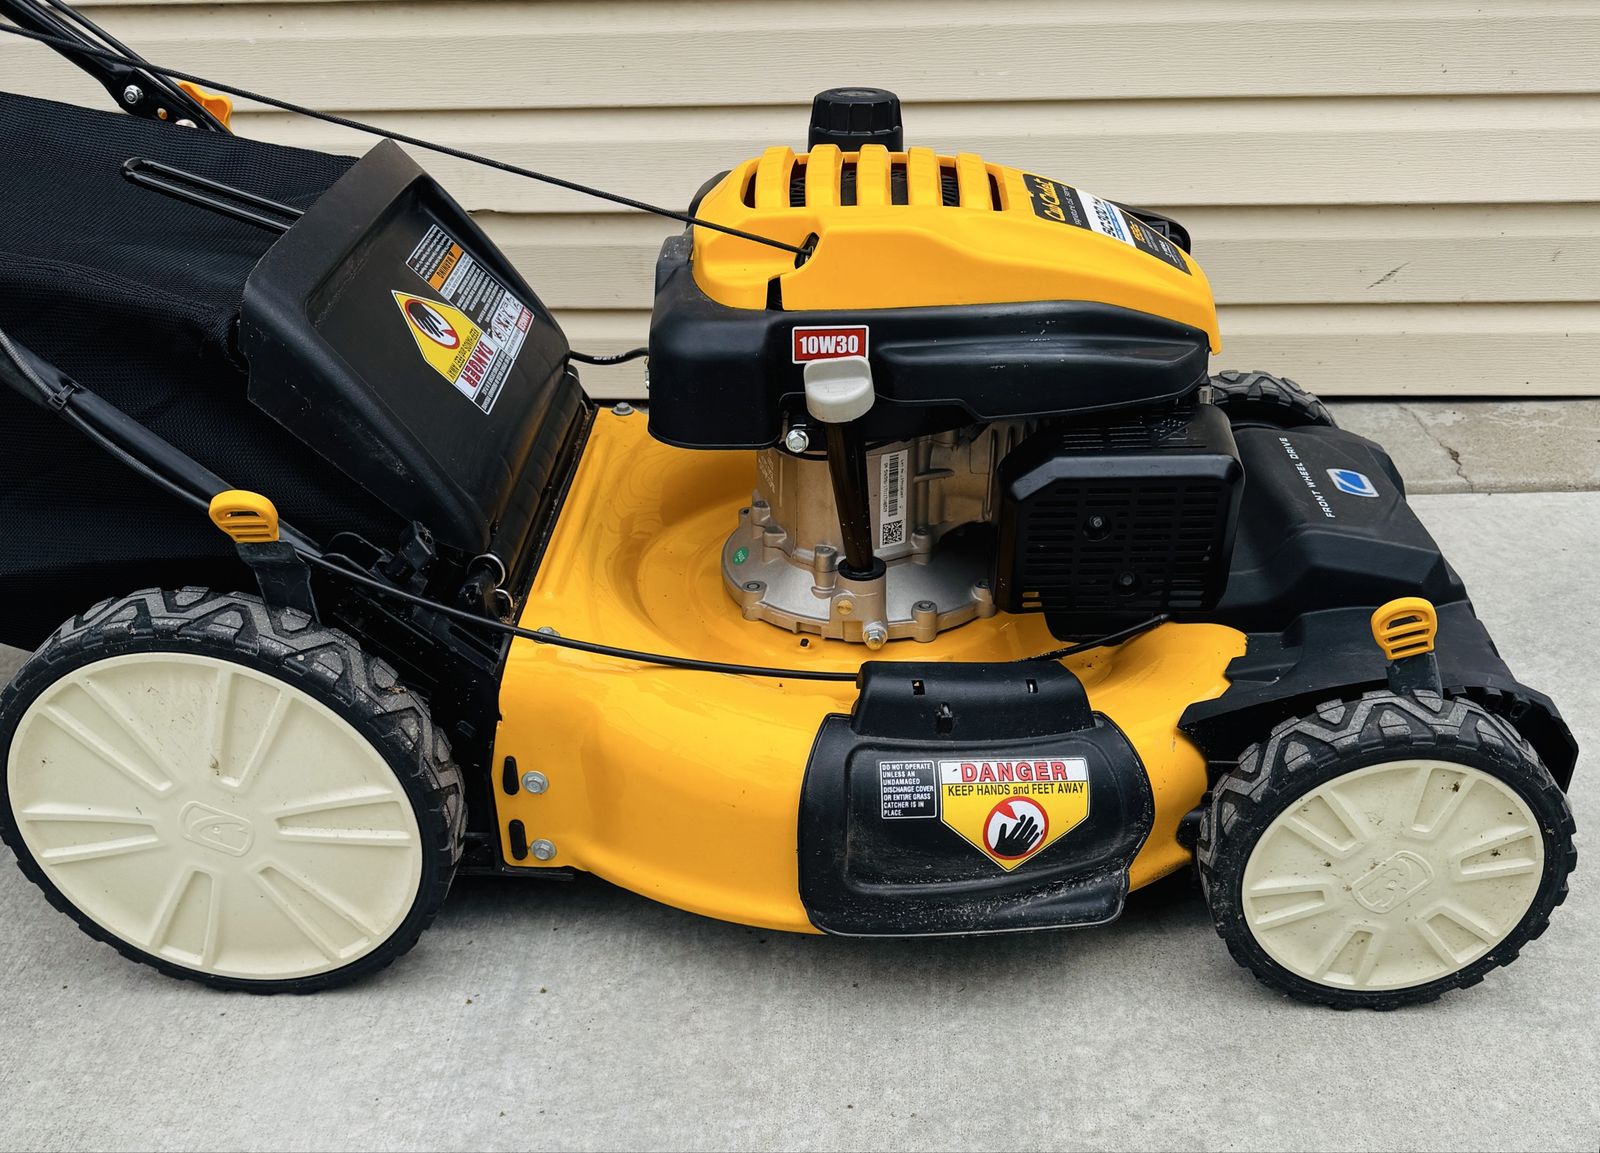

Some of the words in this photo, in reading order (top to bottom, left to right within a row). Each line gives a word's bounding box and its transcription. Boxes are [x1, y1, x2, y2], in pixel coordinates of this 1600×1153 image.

[1033, 178, 1060, 206] Cadet
[1042, 203, 1066, 221] Cub
[436, 255, 454, 279] WARNING
[461, 334, 476, 352] HANDS
[799, 335, 859, 354] 10W30
[452, 353, 466, 368] FEET
[460, 340, 494, 388] DANGER
[446, 363, 460, 380] AWAY
[1278, 437, 1299, 460] DRIVE
[1295, 462, 1316, 488] WHEEL
[1311, 490, 1335, 518] FRONT
[882, 770, 906, 778] UNLESS
[891, 763, 904, 771] NOT
[960, 761, 1068, 782] DANGER
[883, 777, 920, 786] UNDAMAGED
[948, 785, 974, 797] KEEP
[976, 784, 1010, 796] HANDS
[1013, 784, 1029, 795] and
[1032, 783, 1055, 795] FEET
[1057, 782, 1084, 794] AWAY
[883, 801, 910, 809] CATCHER
[893, 793, 912, 801] ENTIRE
[912, 792, 931, 800] GRASS
